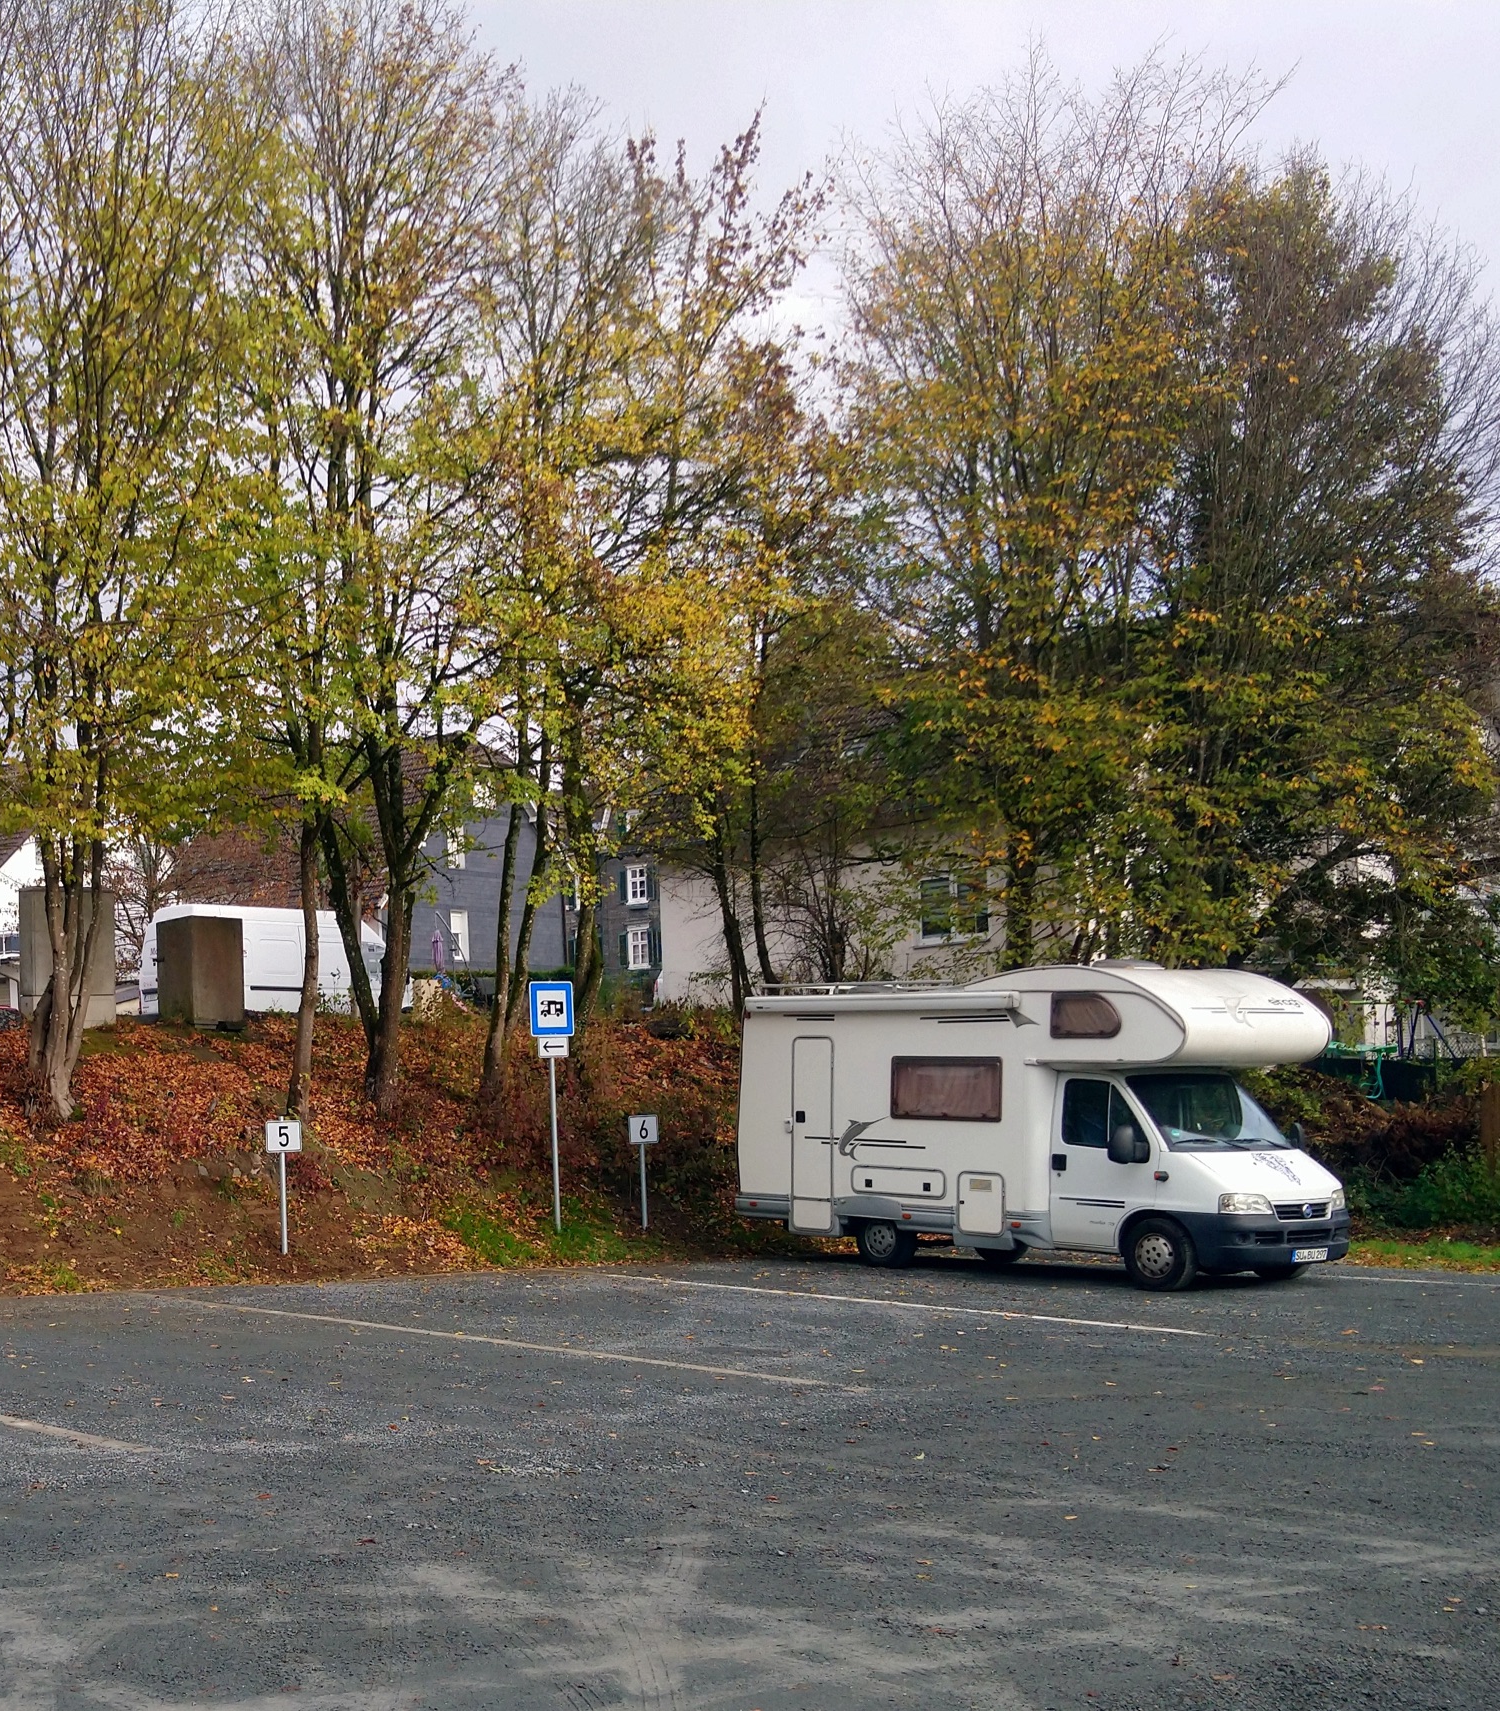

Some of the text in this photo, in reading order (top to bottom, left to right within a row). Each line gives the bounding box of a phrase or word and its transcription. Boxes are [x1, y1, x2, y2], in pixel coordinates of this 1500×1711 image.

[278, 1125, 290, 1148] 5
[639, 1119, 649, 1139] 6
[1315, 1249, 1328, 1260] 297
